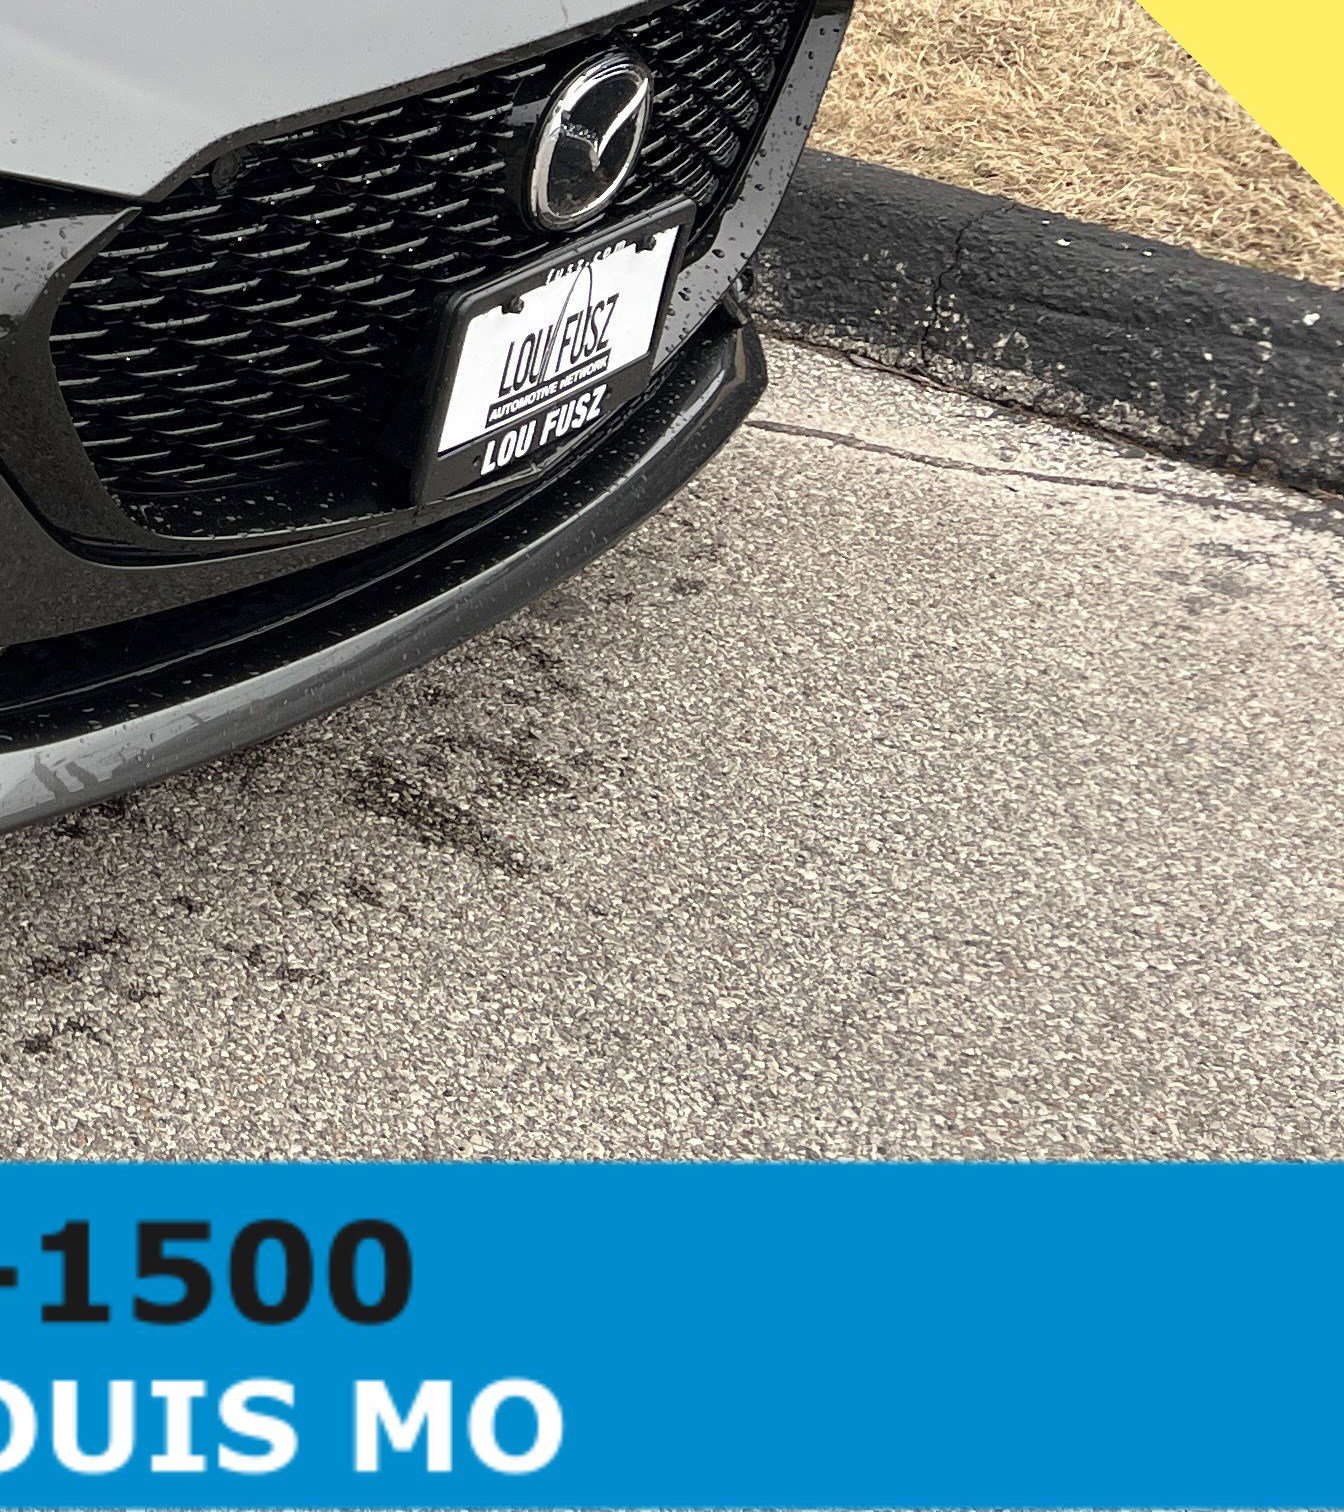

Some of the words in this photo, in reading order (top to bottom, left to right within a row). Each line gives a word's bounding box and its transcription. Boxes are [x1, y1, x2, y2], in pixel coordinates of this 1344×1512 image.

[488, 380, 559, 423] AUTOMOTIVE
[559, 355, 609, 390] NETWORK
[498, 325, 554, 398] LOU
[555, 292, 620, 373] FUSZ
[480, 419, 537, 476] LOU
[539, 383, 608, 446] FUSZ
